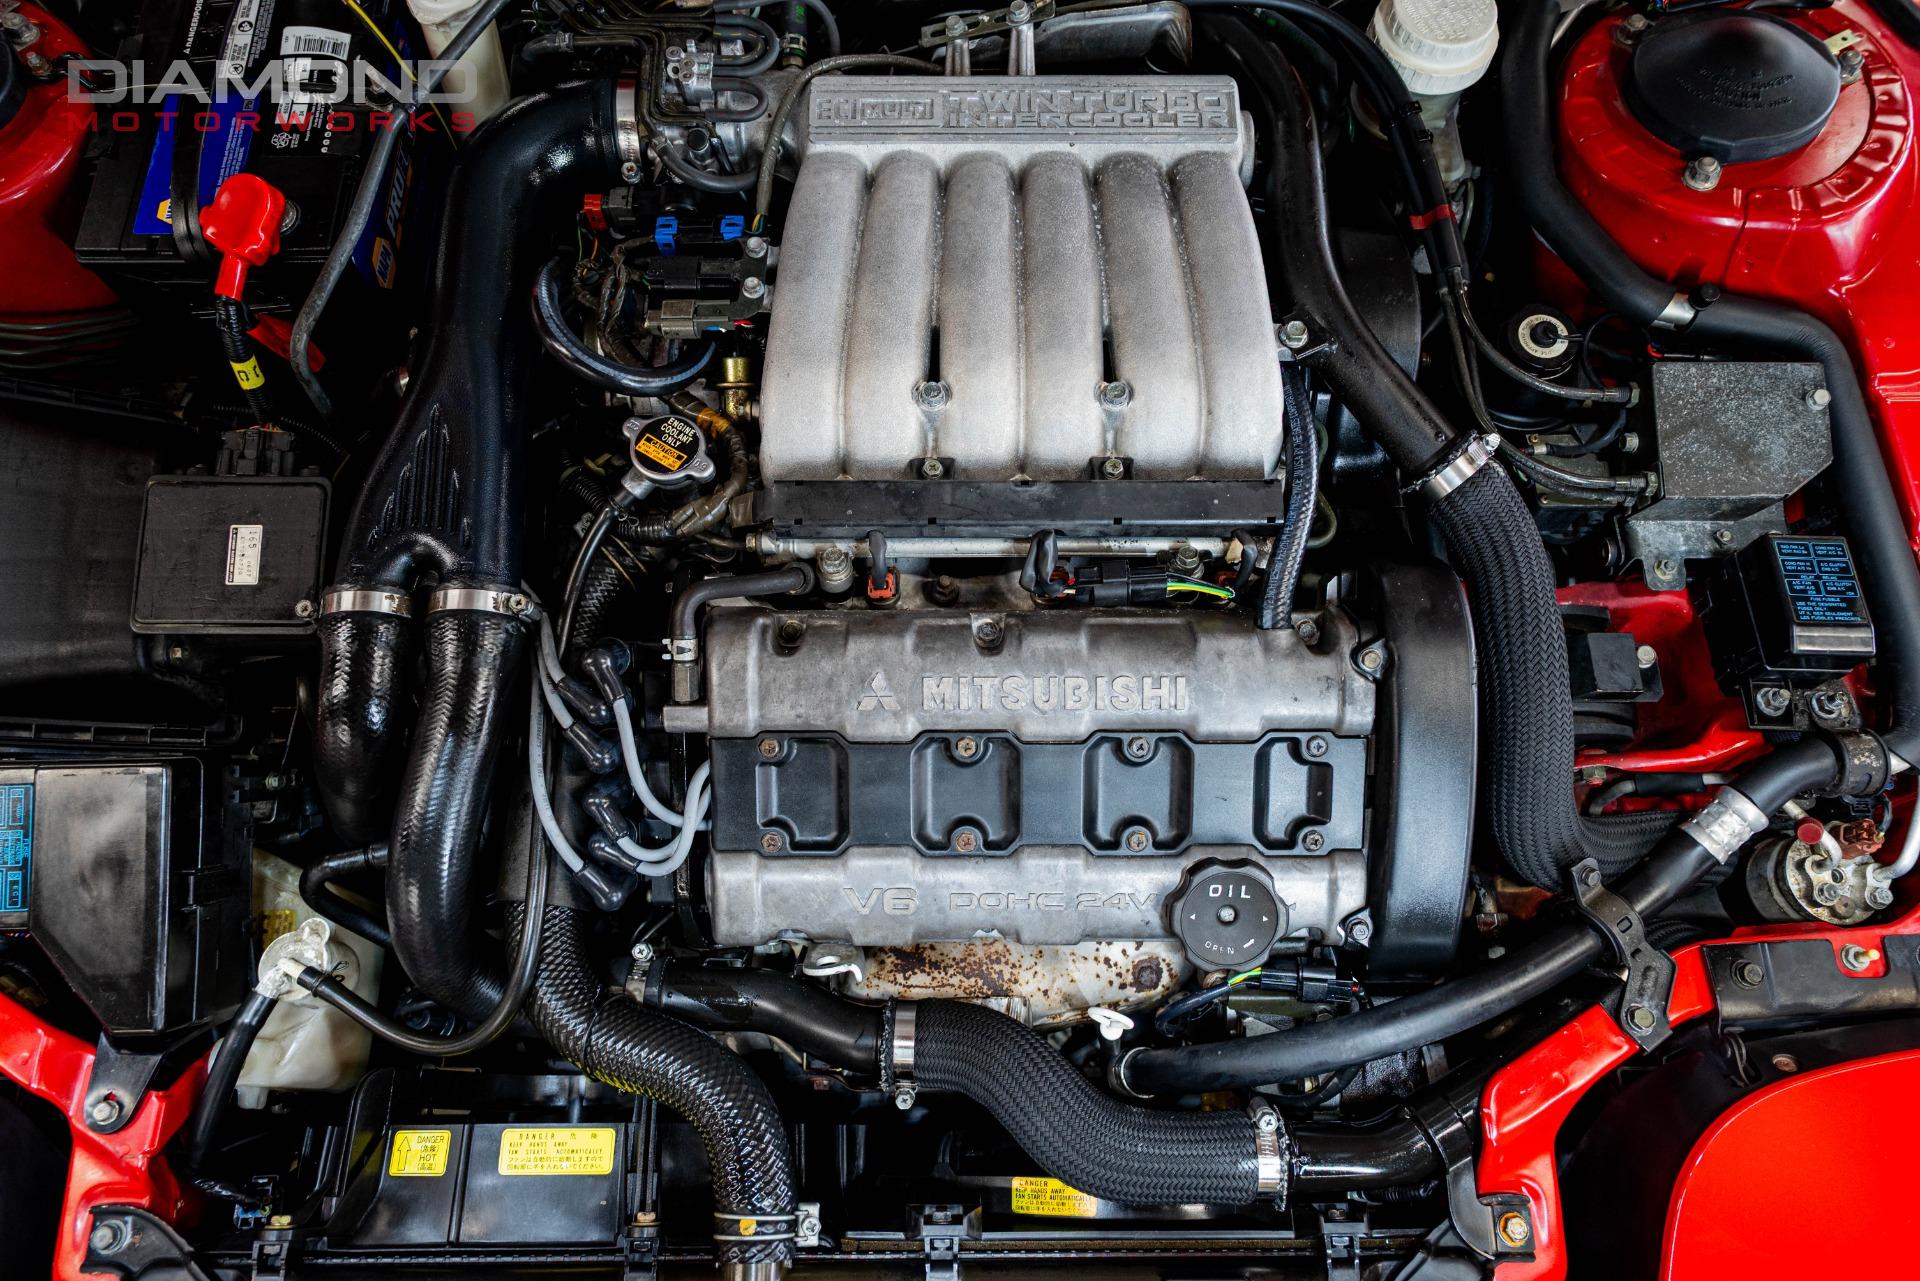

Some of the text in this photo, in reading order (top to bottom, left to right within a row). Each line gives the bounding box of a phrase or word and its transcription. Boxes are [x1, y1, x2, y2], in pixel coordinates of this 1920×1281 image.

[816, 98, 934, 120] ECI MULTI
[950, 90, 1227, 112] TWIN TURBO
[948, 111, 1228, 127] INTERCOOLER
[660, 423, 693, 444] COOLANT
[668, 417, 696, 437] ENGINE
[650, 440, 679, 458] CAUTION
[661, 433, 682, 448] ONLY
[921, 674, 1187, 712] MITSUBISHI
[1208, 884, 1251, 899] OIL
[843, 887, 919, 916] V6
[949, 891, 1158, 912] DOHC 24V
[1204, 940, 1235, 955] OPEN
[416, 1135, 445, 1144] DANGER
[418, 1153, 437, 1162] HOT
